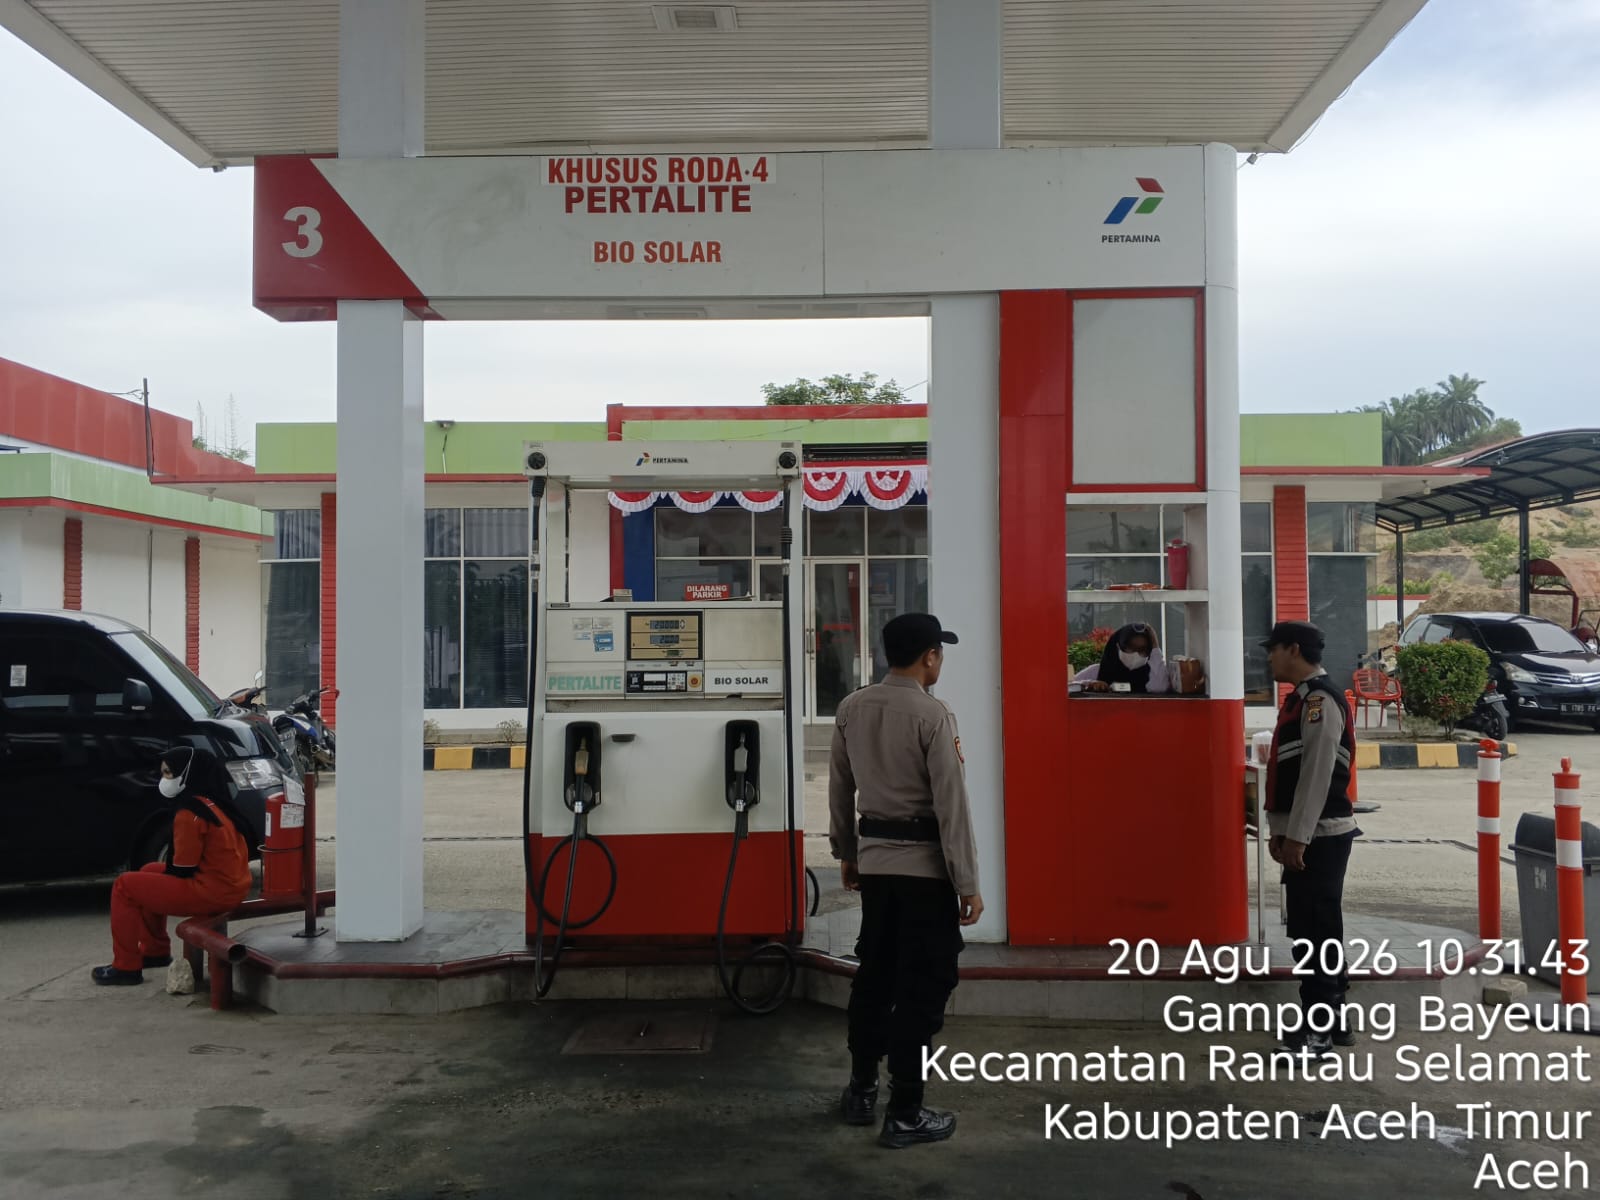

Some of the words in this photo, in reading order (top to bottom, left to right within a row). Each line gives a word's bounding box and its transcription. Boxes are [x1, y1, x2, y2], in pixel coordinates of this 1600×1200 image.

[548, 157, 658, 184] KHUSUS
[564, 185, 751, 213] PERTALITE
[281, 206, 324, 258] 3
[1101, 234, 1161, 243] PERTAMINA
[594, 241, 635, 263] BIO
[643, 241, 722, 263] SOLAR
[687, 584, 727, 592] DILARANG
[548, 675, 622, 691] PERTALITE
[714, 677, 732, 685] BIO
[735, 676, 769, 685] SOLAR
